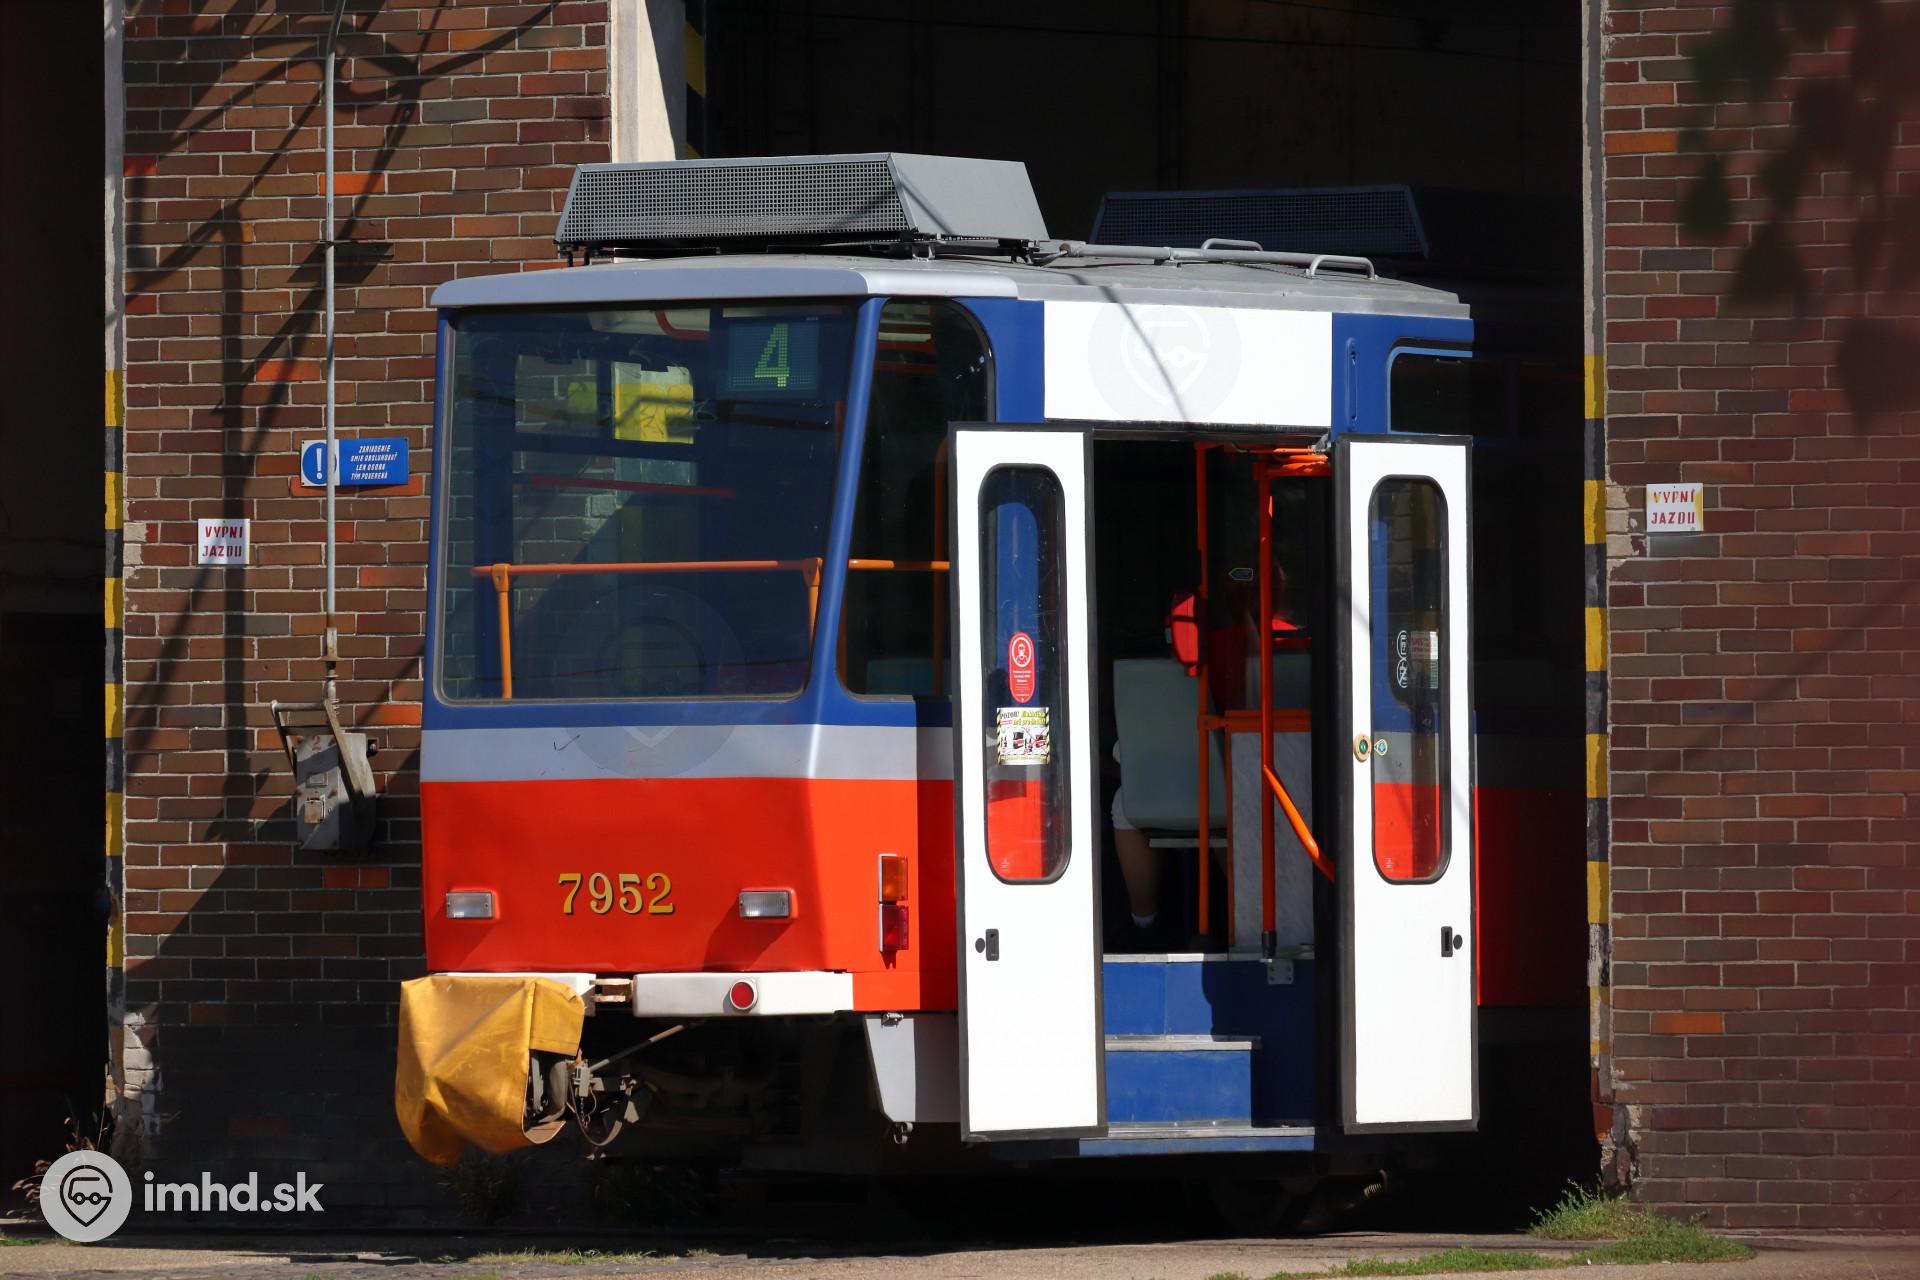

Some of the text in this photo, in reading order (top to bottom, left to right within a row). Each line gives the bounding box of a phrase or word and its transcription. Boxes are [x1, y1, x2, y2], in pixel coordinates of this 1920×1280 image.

[754, 323, 789, 388] 4
[1651, 511, 1695, 524] JAZDU
[202, 545, 242, 557] JAZDU
[559, 872, 674, 914] 7952
